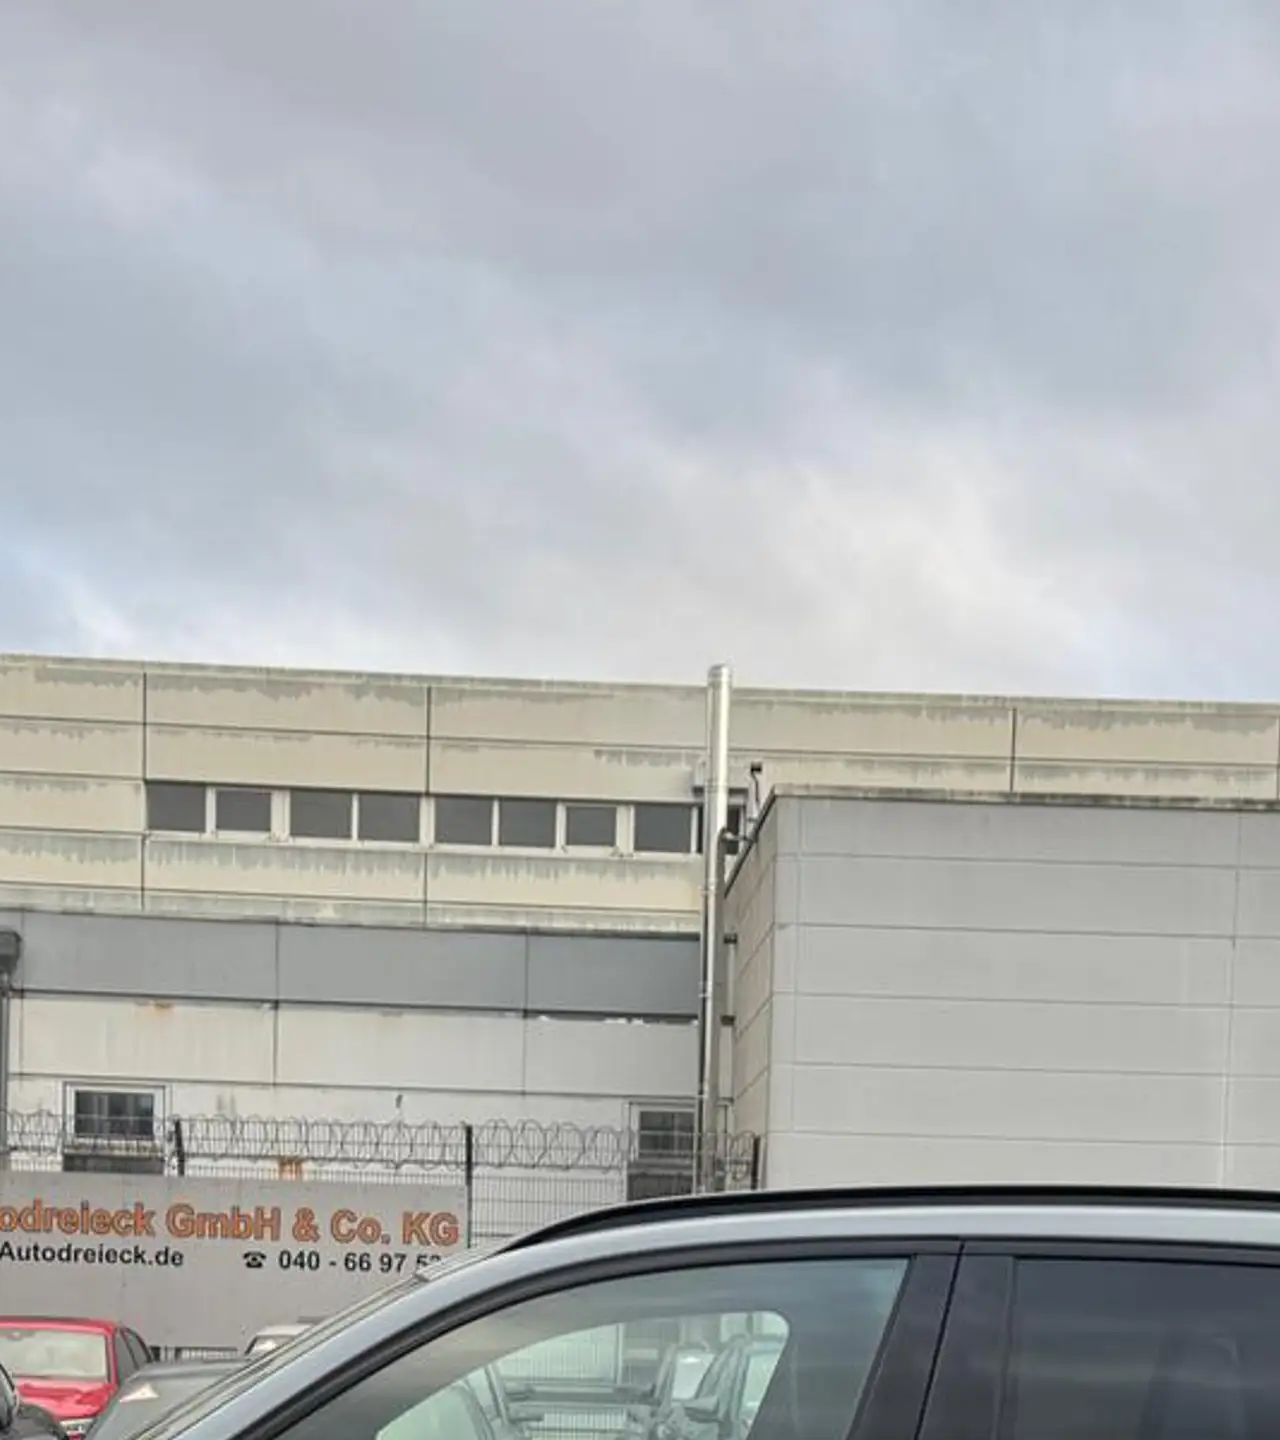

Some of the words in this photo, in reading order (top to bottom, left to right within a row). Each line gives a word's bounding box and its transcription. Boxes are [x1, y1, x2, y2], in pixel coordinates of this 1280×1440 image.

[166, 1203, 281, 1241] GmbH
[292, 1207, 320, 1243] &
[331, 1208, 390, 1244] Co.
[402, 1211, 459, 1246] KG
[278, 1250, 321, 1271] 040
[344, 1252, 372, 1273] 66
[379, 1253, 407, 1274] 97
